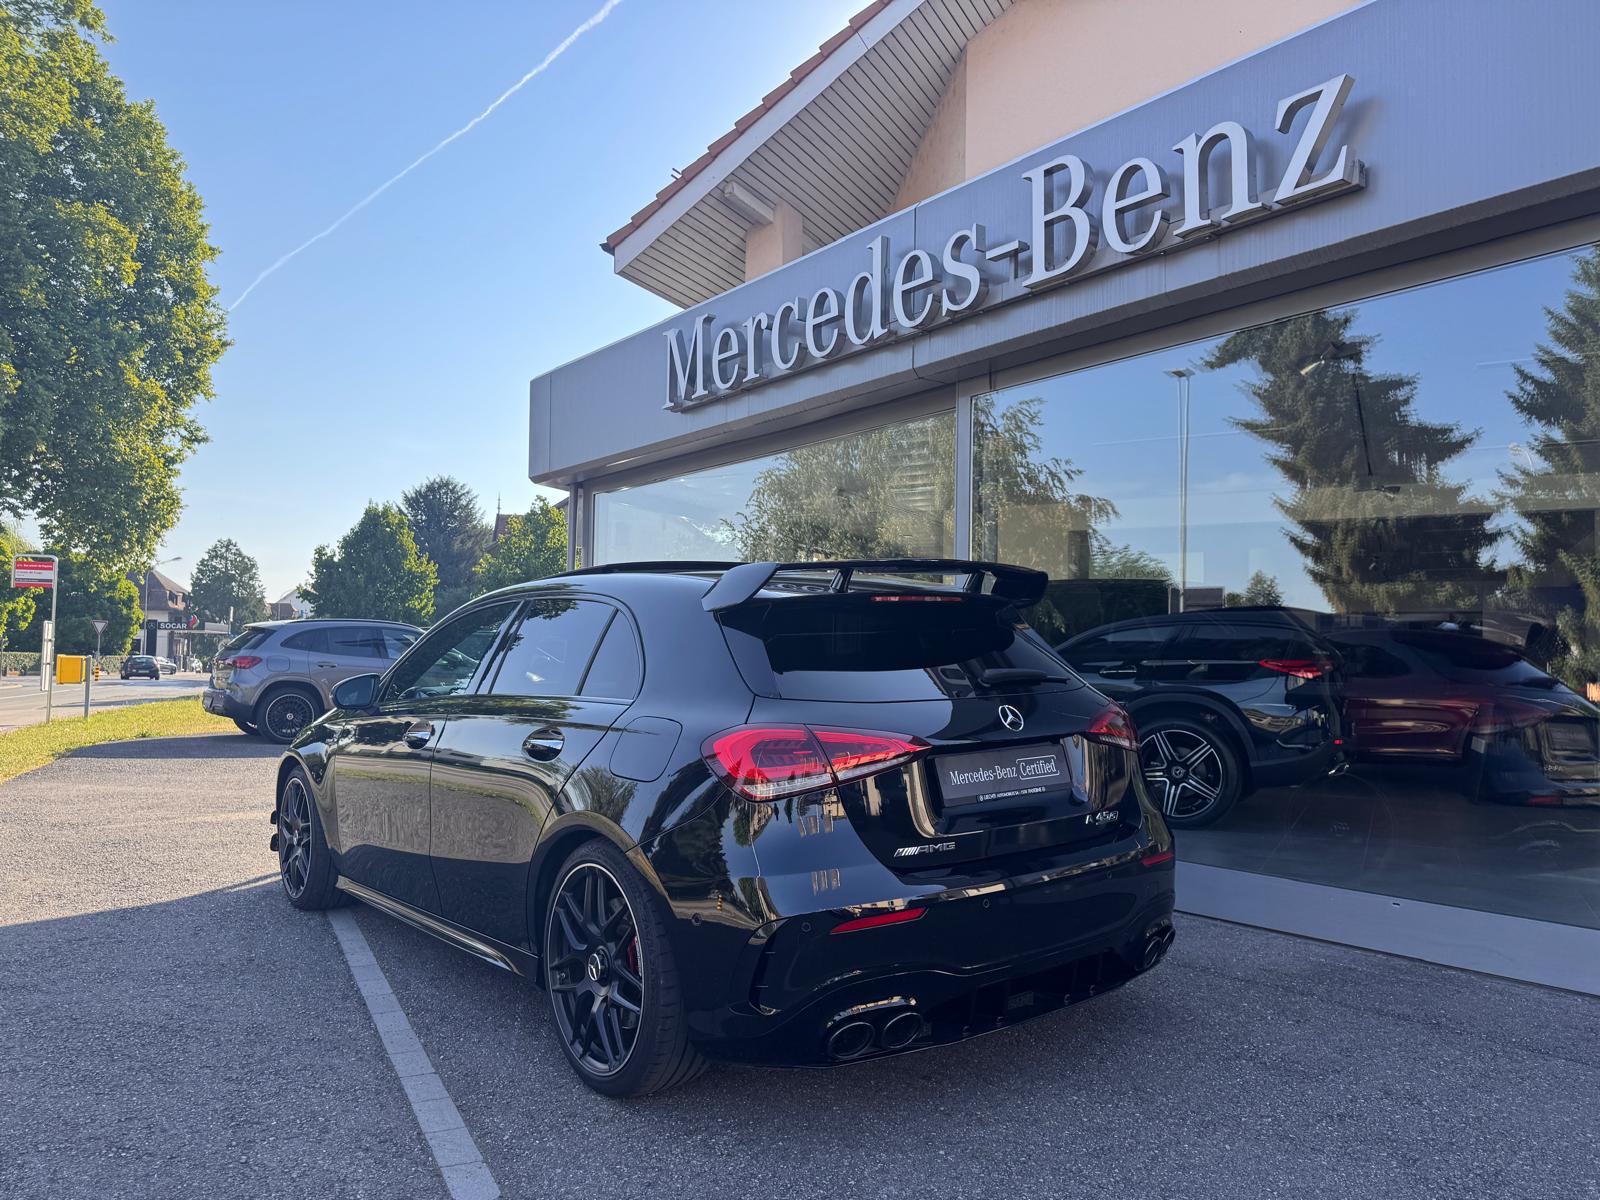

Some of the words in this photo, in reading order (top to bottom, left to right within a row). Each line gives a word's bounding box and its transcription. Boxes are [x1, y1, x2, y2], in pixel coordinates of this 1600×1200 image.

[663, 74, 1363, 411] Mercedes-Benz
[159, 622, 188, 630] SOCAR
[949, 765, 1018, 786] Mercedes-Benz
[1019, 758, 1057, 777] Certified
[915, 841, 956, 855] AMG
